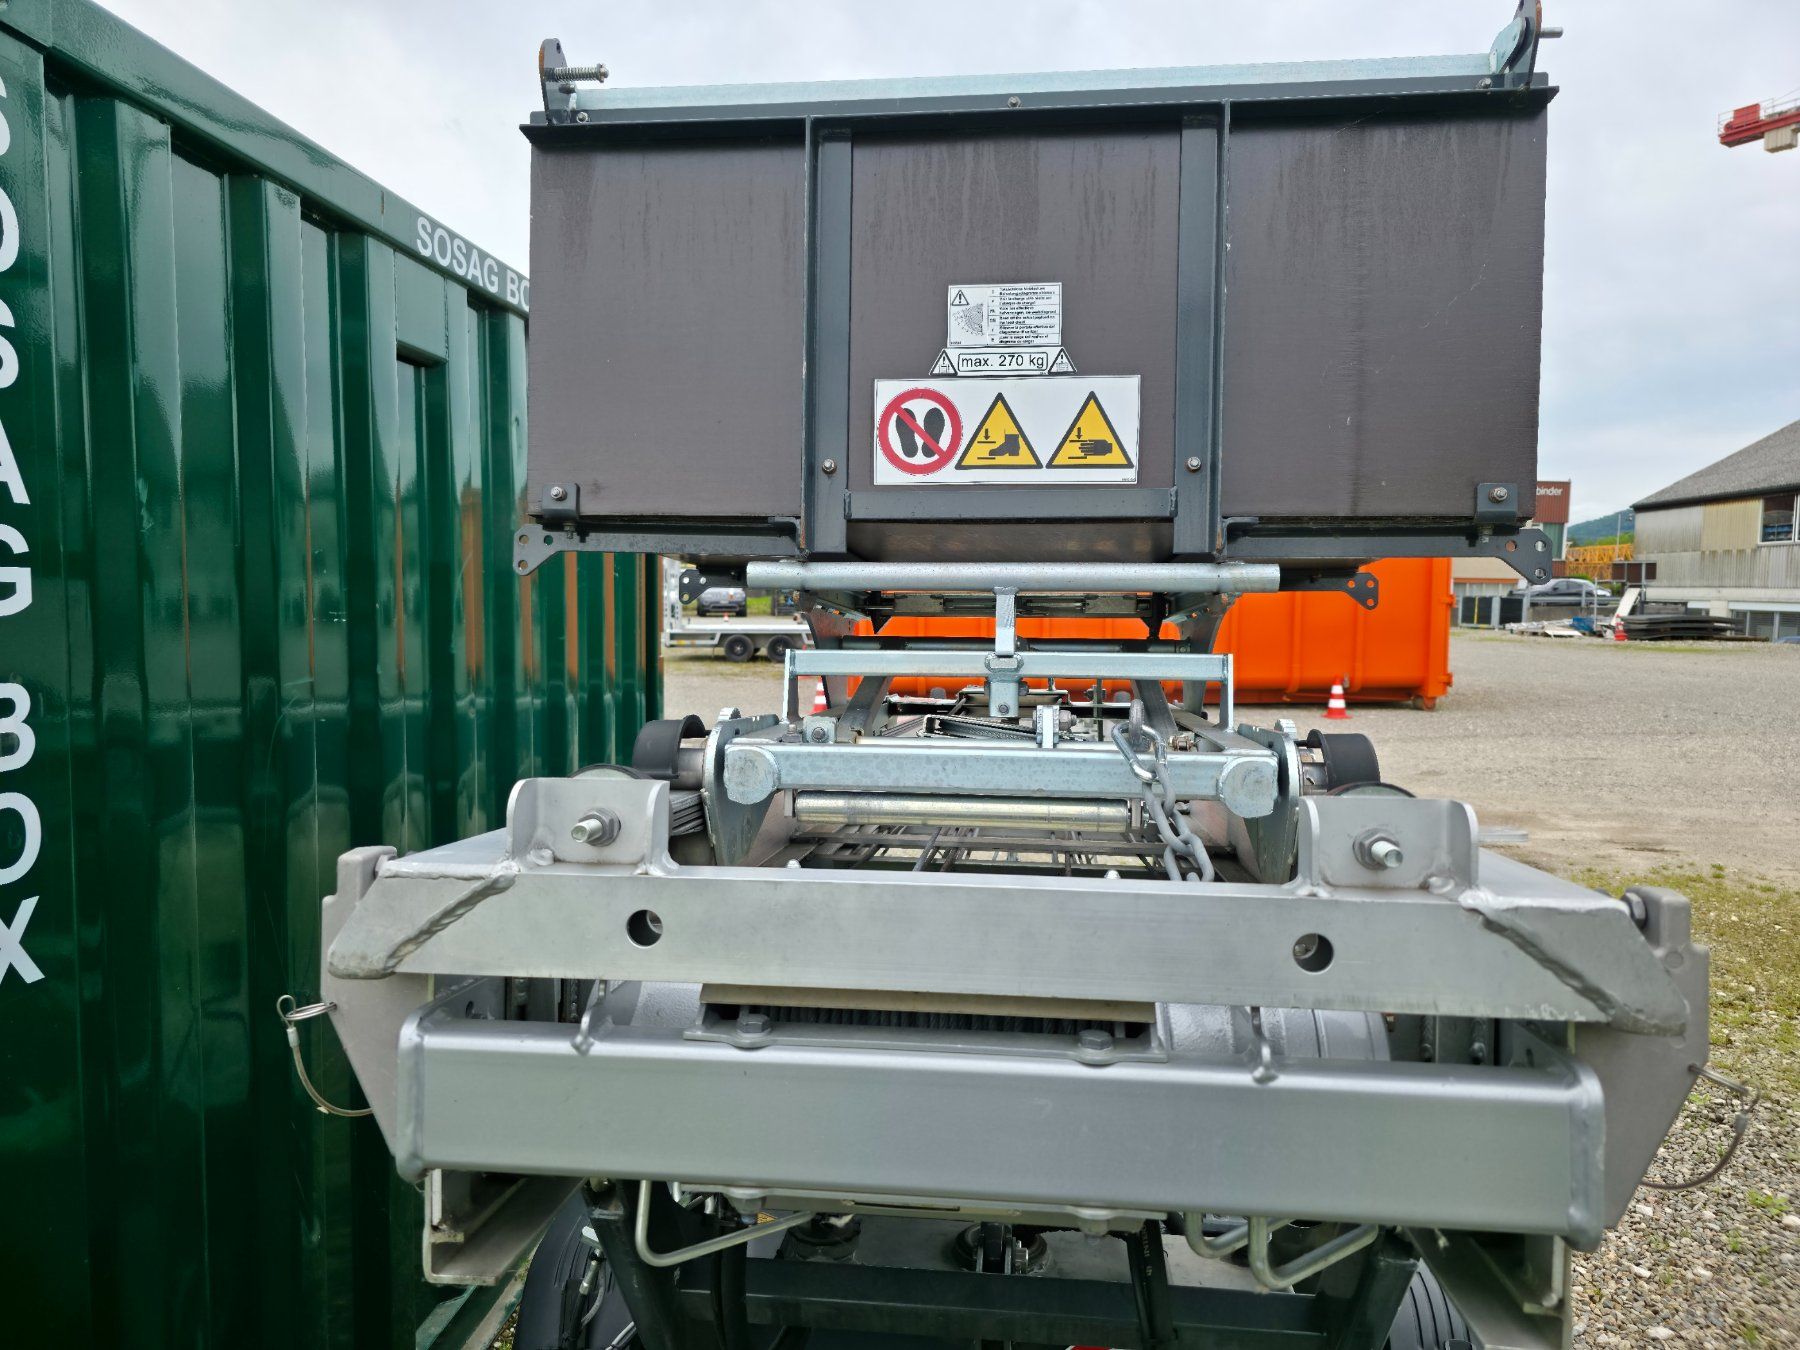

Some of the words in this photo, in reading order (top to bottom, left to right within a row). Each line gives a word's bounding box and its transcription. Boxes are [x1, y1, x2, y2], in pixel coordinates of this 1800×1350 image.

[417, 216, 499, 294] SOSAG
[961, 357, 993, 368] max.
[999, 354, 1024, 367] 270
[1029, 354, 1044, 369] kg
